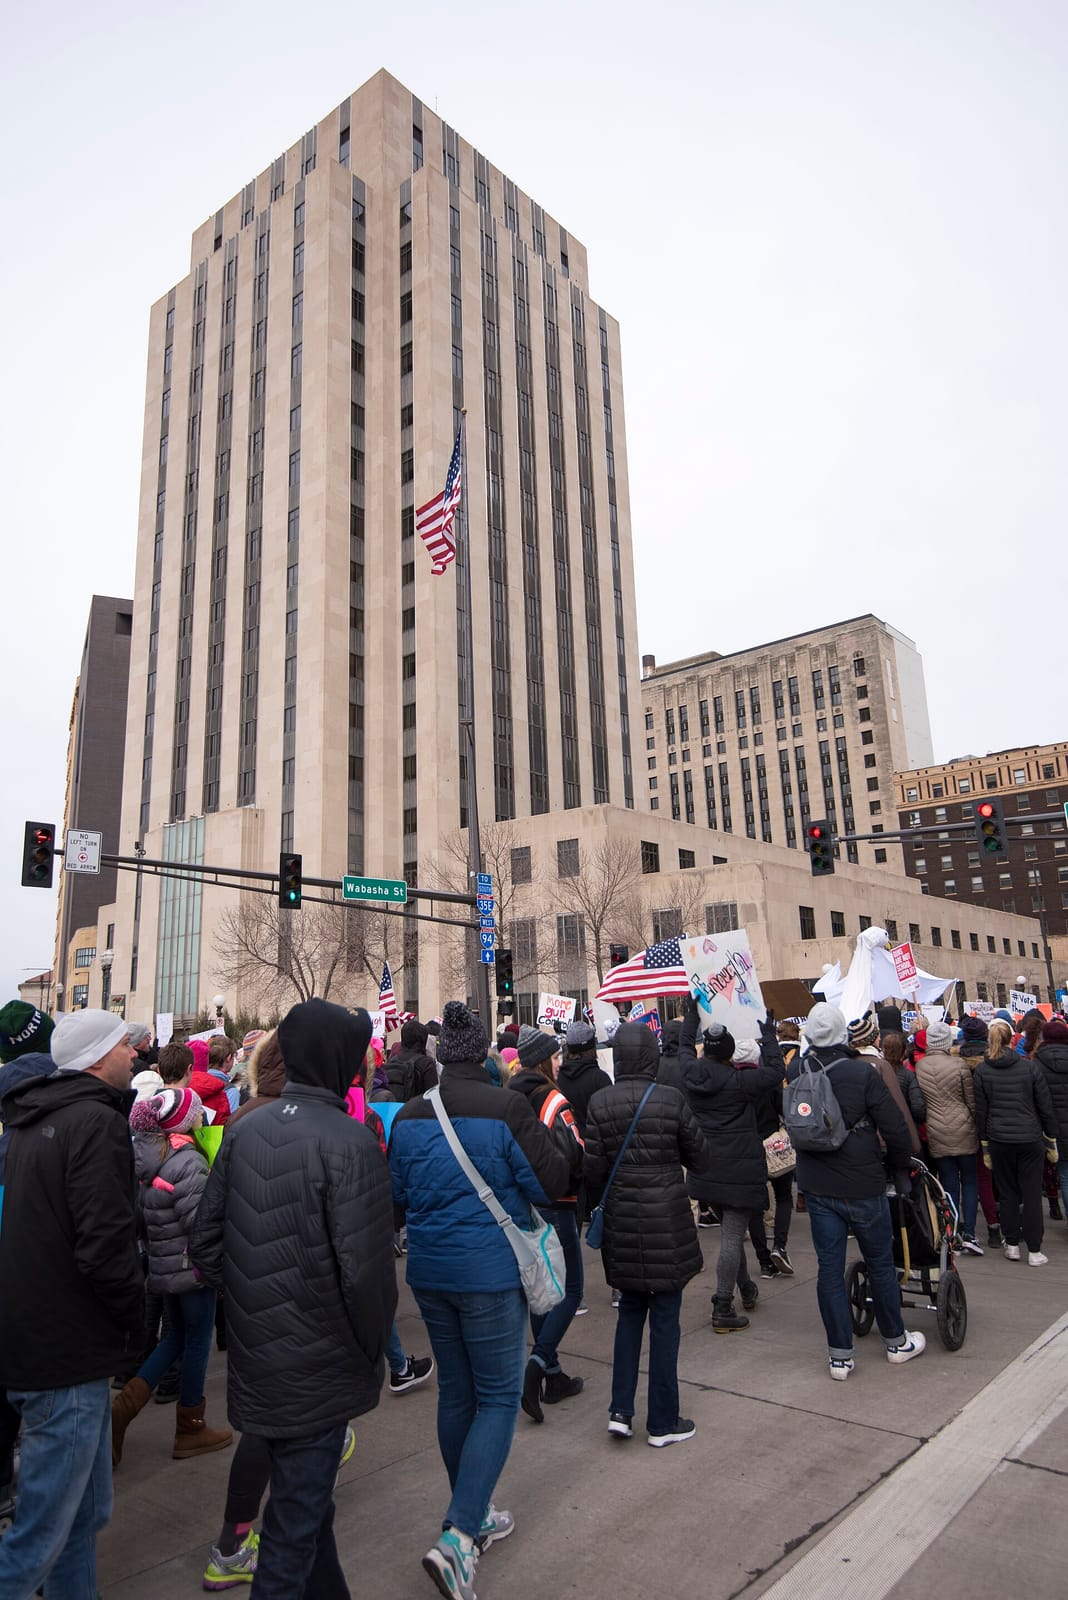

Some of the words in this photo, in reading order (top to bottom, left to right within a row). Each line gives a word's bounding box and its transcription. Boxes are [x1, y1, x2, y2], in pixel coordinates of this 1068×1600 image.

[481, 875, 489, 883] TO
[346, 883, 389, 895] Wabasha
[393, 887, 404, 896] St
[479, 900, 492, 911] 35E
[482, 918, 493, 926] WEST
[482, 934, 493, 944] 94
[1012, 993, 1034, 1006] #Vote
[545, 1007, 566, 1018] gun
